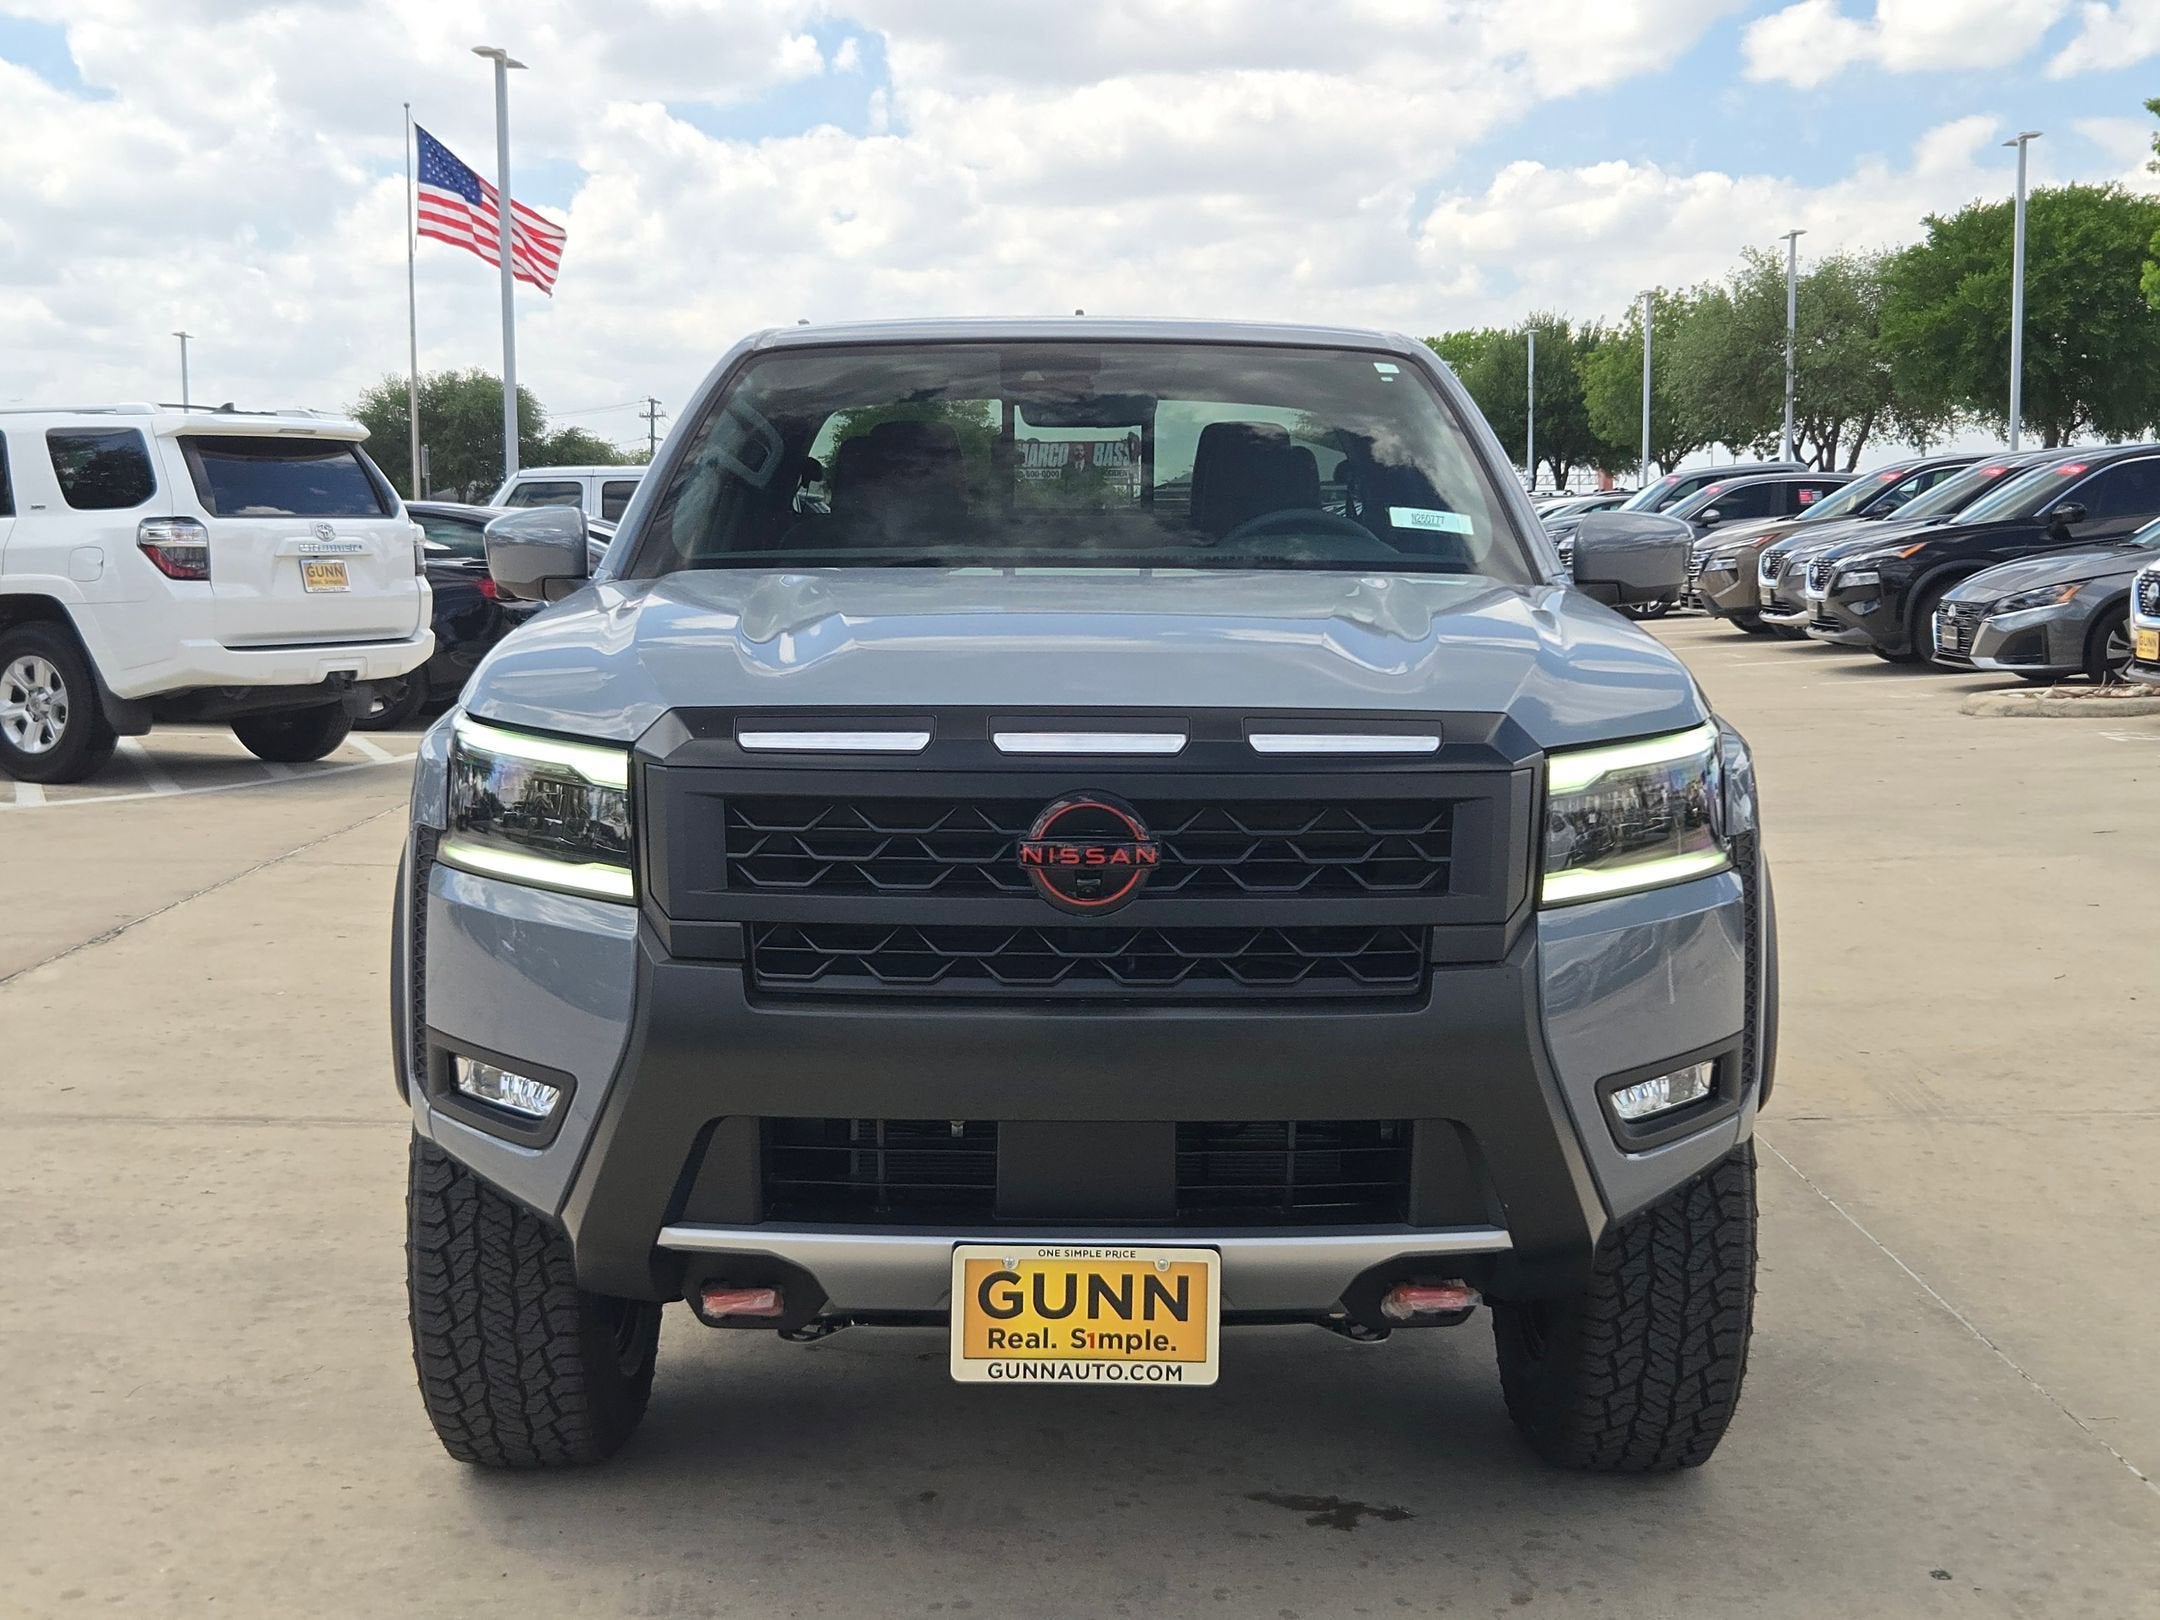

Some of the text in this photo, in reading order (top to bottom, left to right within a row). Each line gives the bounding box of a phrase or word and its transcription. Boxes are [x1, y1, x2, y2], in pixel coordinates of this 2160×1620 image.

[306, 565, 344, 577] GUNN
[1021, 847, 1157, 865] NISSAN
[1038, 1249, 1136, 1259] ONE SIMPLE PRICE
[977, 1271, 1189, 1322] GUNN
[988, 1327, 1177, 1354] Real. S1mple.
[987, 1363, 1183, 1381] GUNNAUTO.COM
